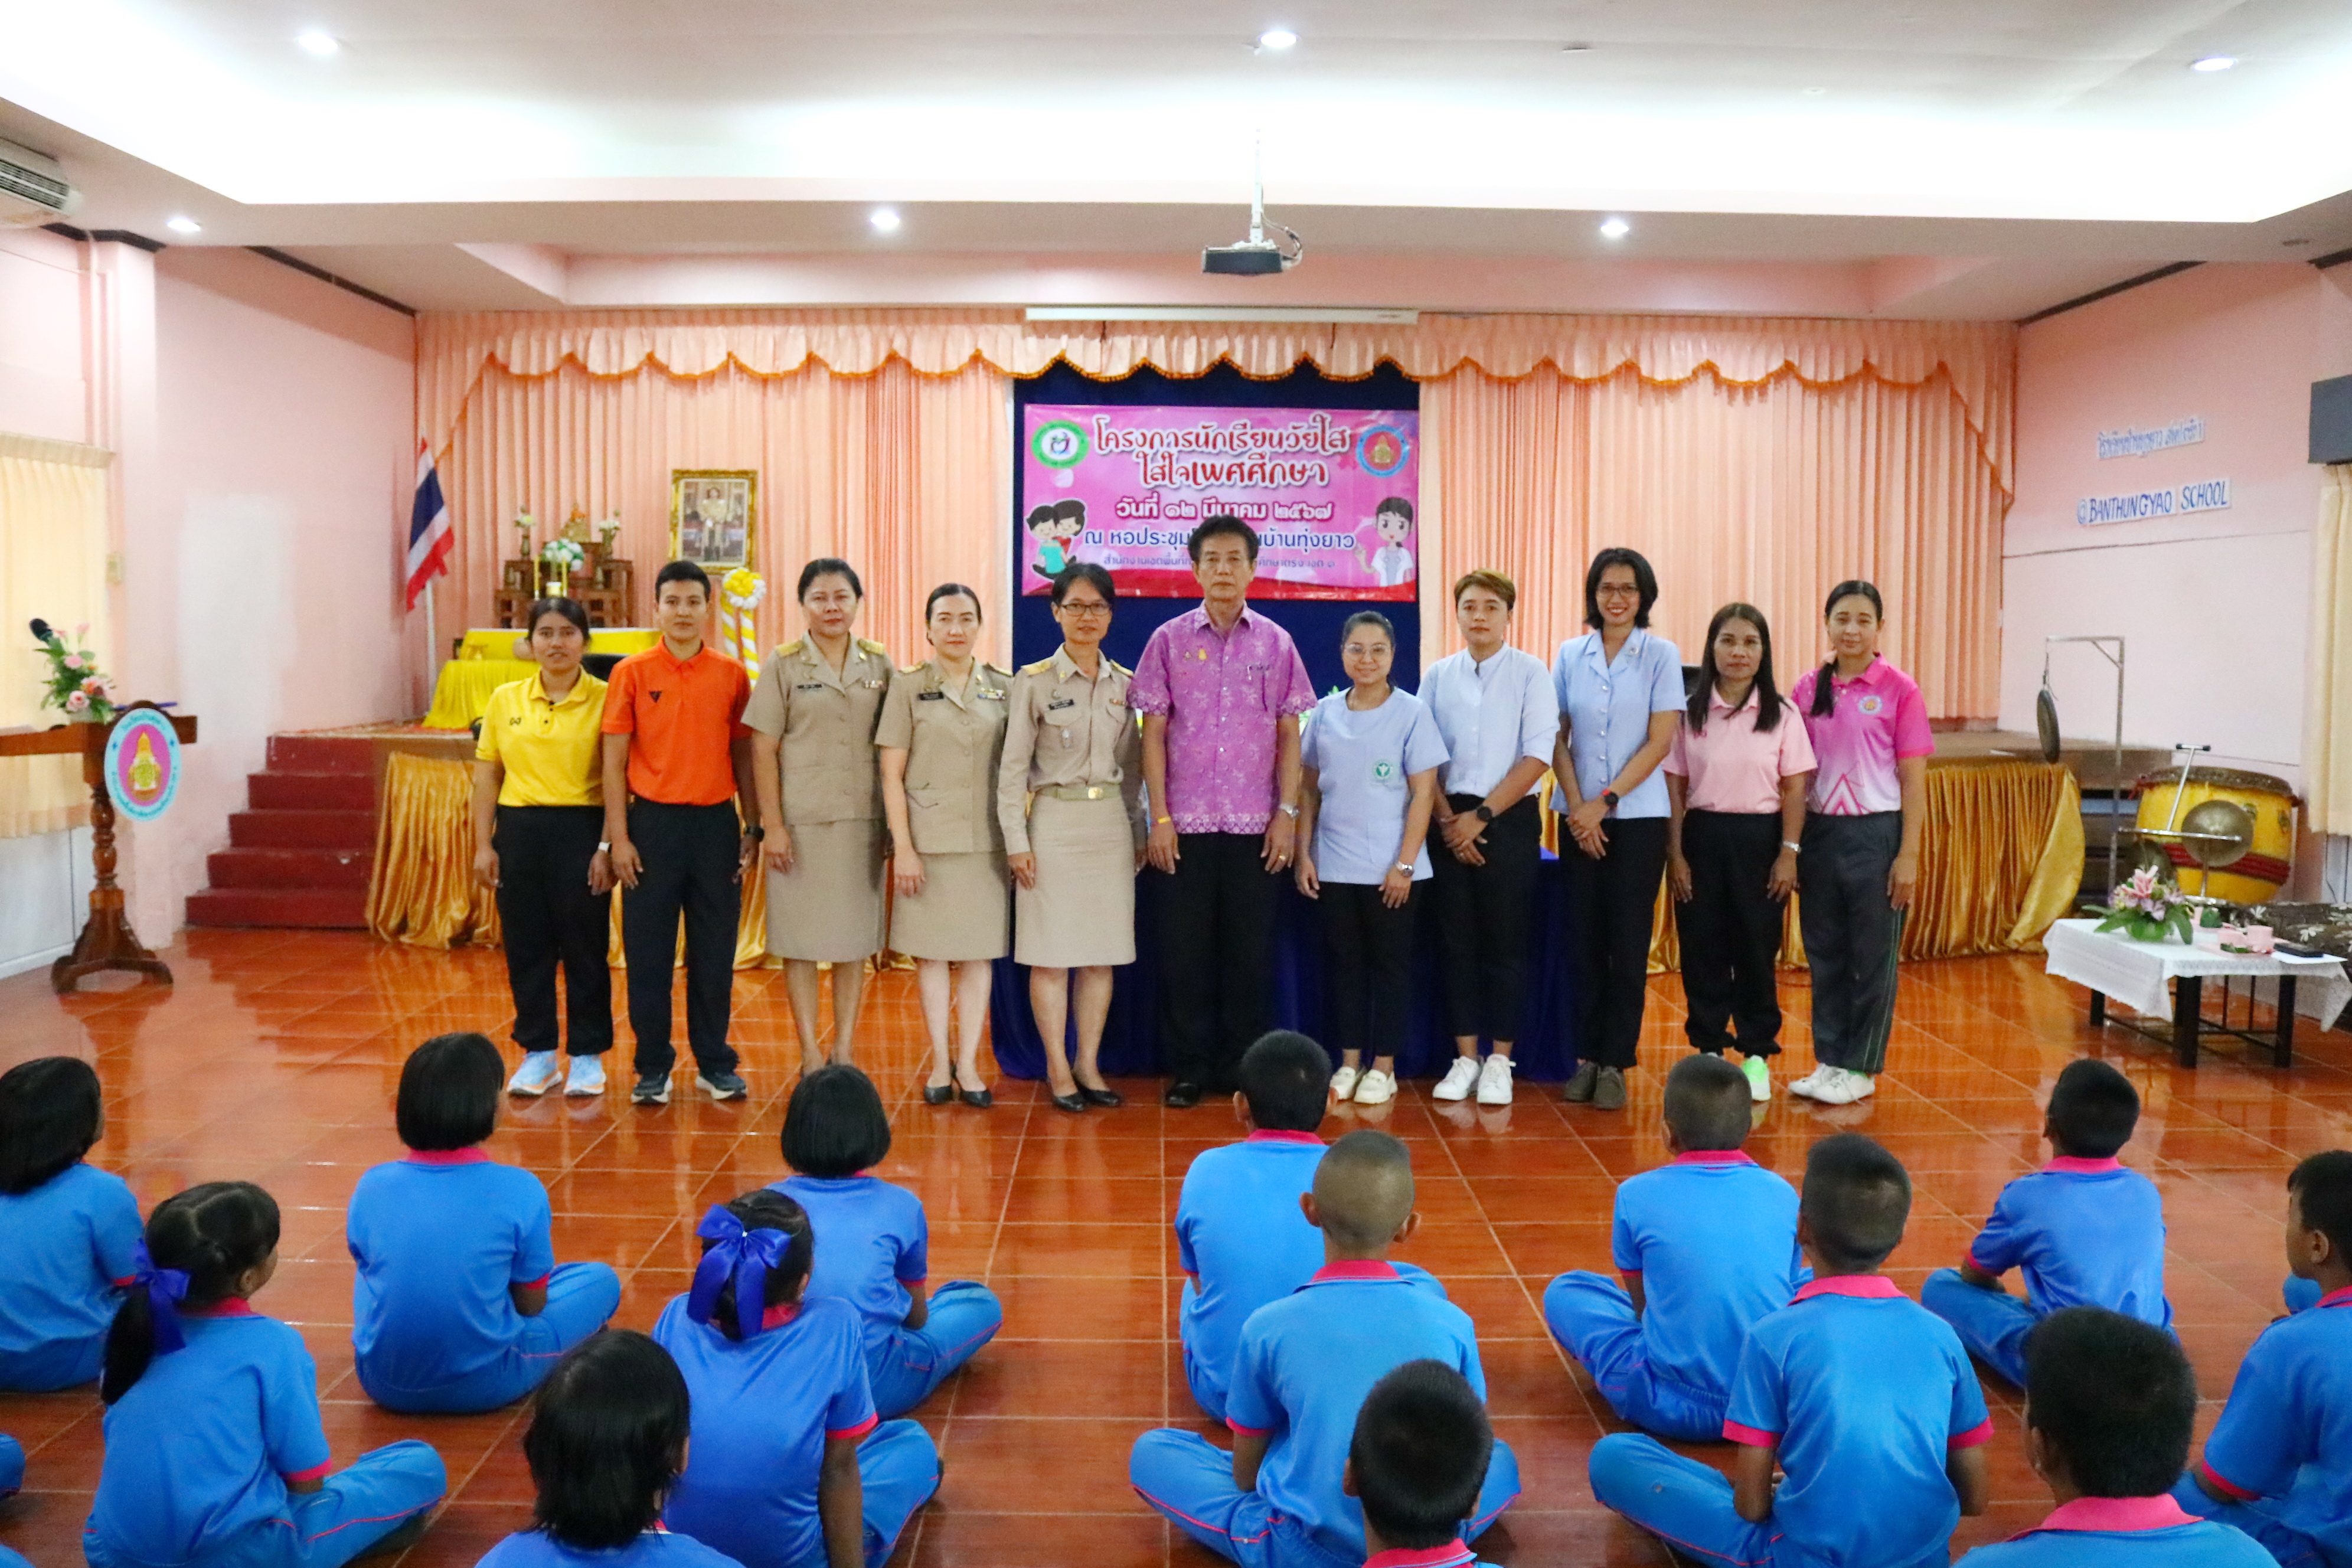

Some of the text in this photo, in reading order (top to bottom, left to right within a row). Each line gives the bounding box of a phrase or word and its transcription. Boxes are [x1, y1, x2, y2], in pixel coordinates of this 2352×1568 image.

[1095, 413, 1347, 452] โครงการนักเรียนวัยใส
[1115, 491, 1334, 521] วันที่ ๑๒ มีนาคม ๒๕๖๗
[2181, 481, 2228, 510] SCHOOL
[1085, 531, 1103, 545] ณ
[1110, 527, 1200, 550] หอประชุม
